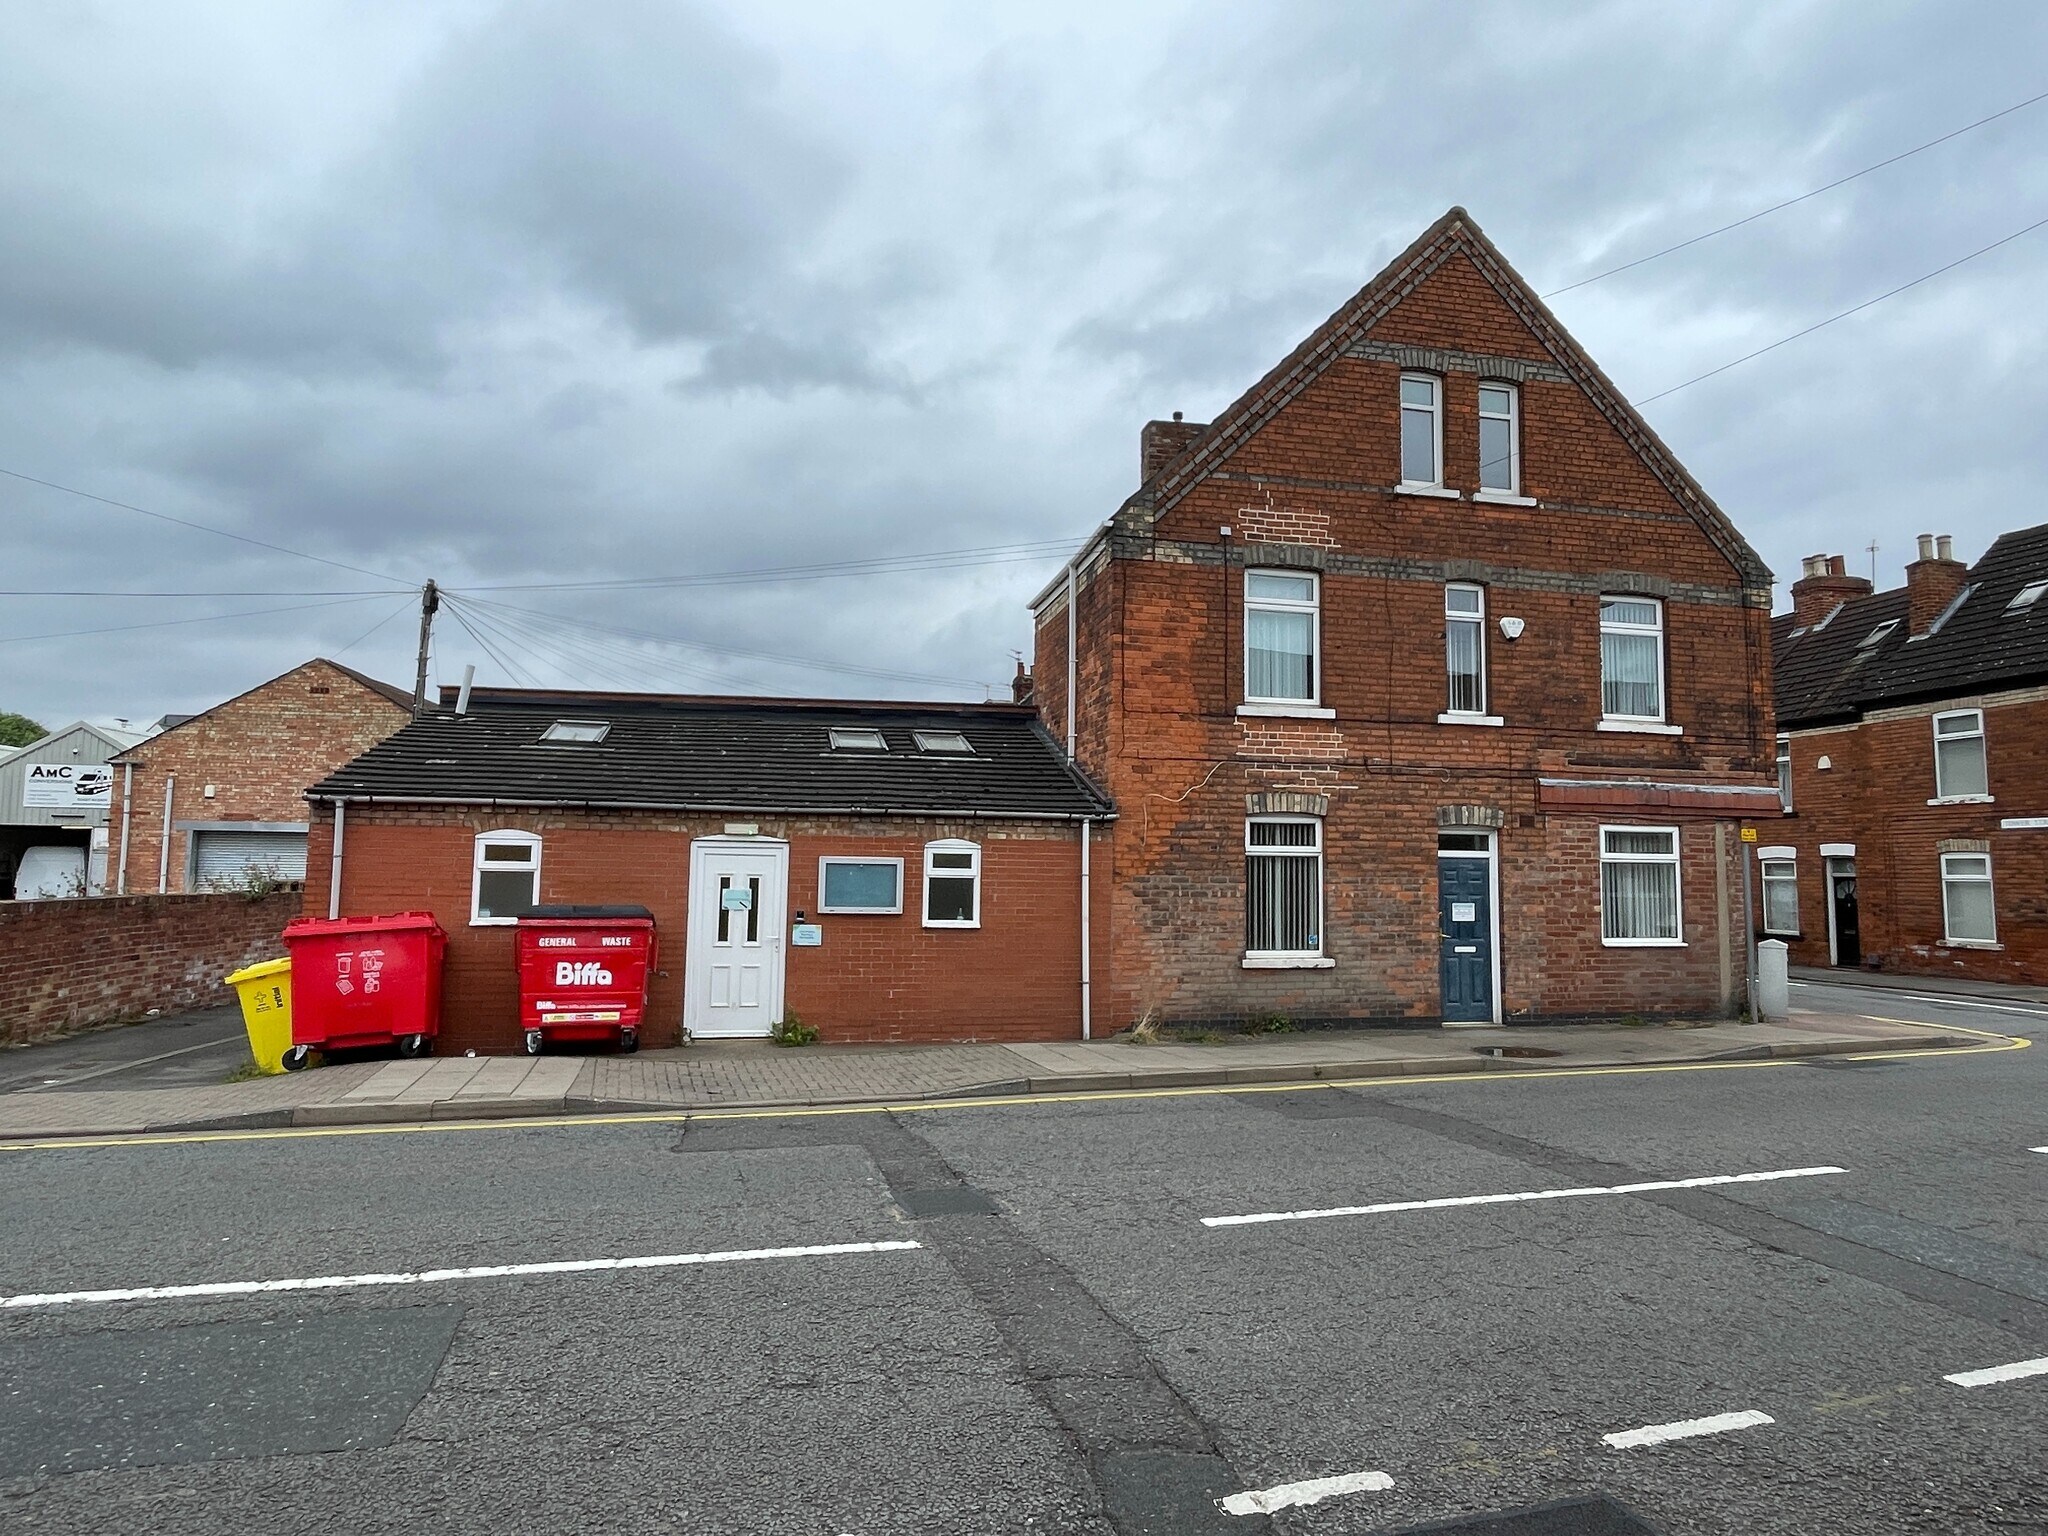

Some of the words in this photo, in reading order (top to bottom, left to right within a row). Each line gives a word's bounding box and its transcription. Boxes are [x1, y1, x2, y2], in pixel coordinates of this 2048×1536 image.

[538, 937, 576, 947] GENERAL
[601, 936, 631, 946] WASTE
[555, 961, 612, 985] Biffa
